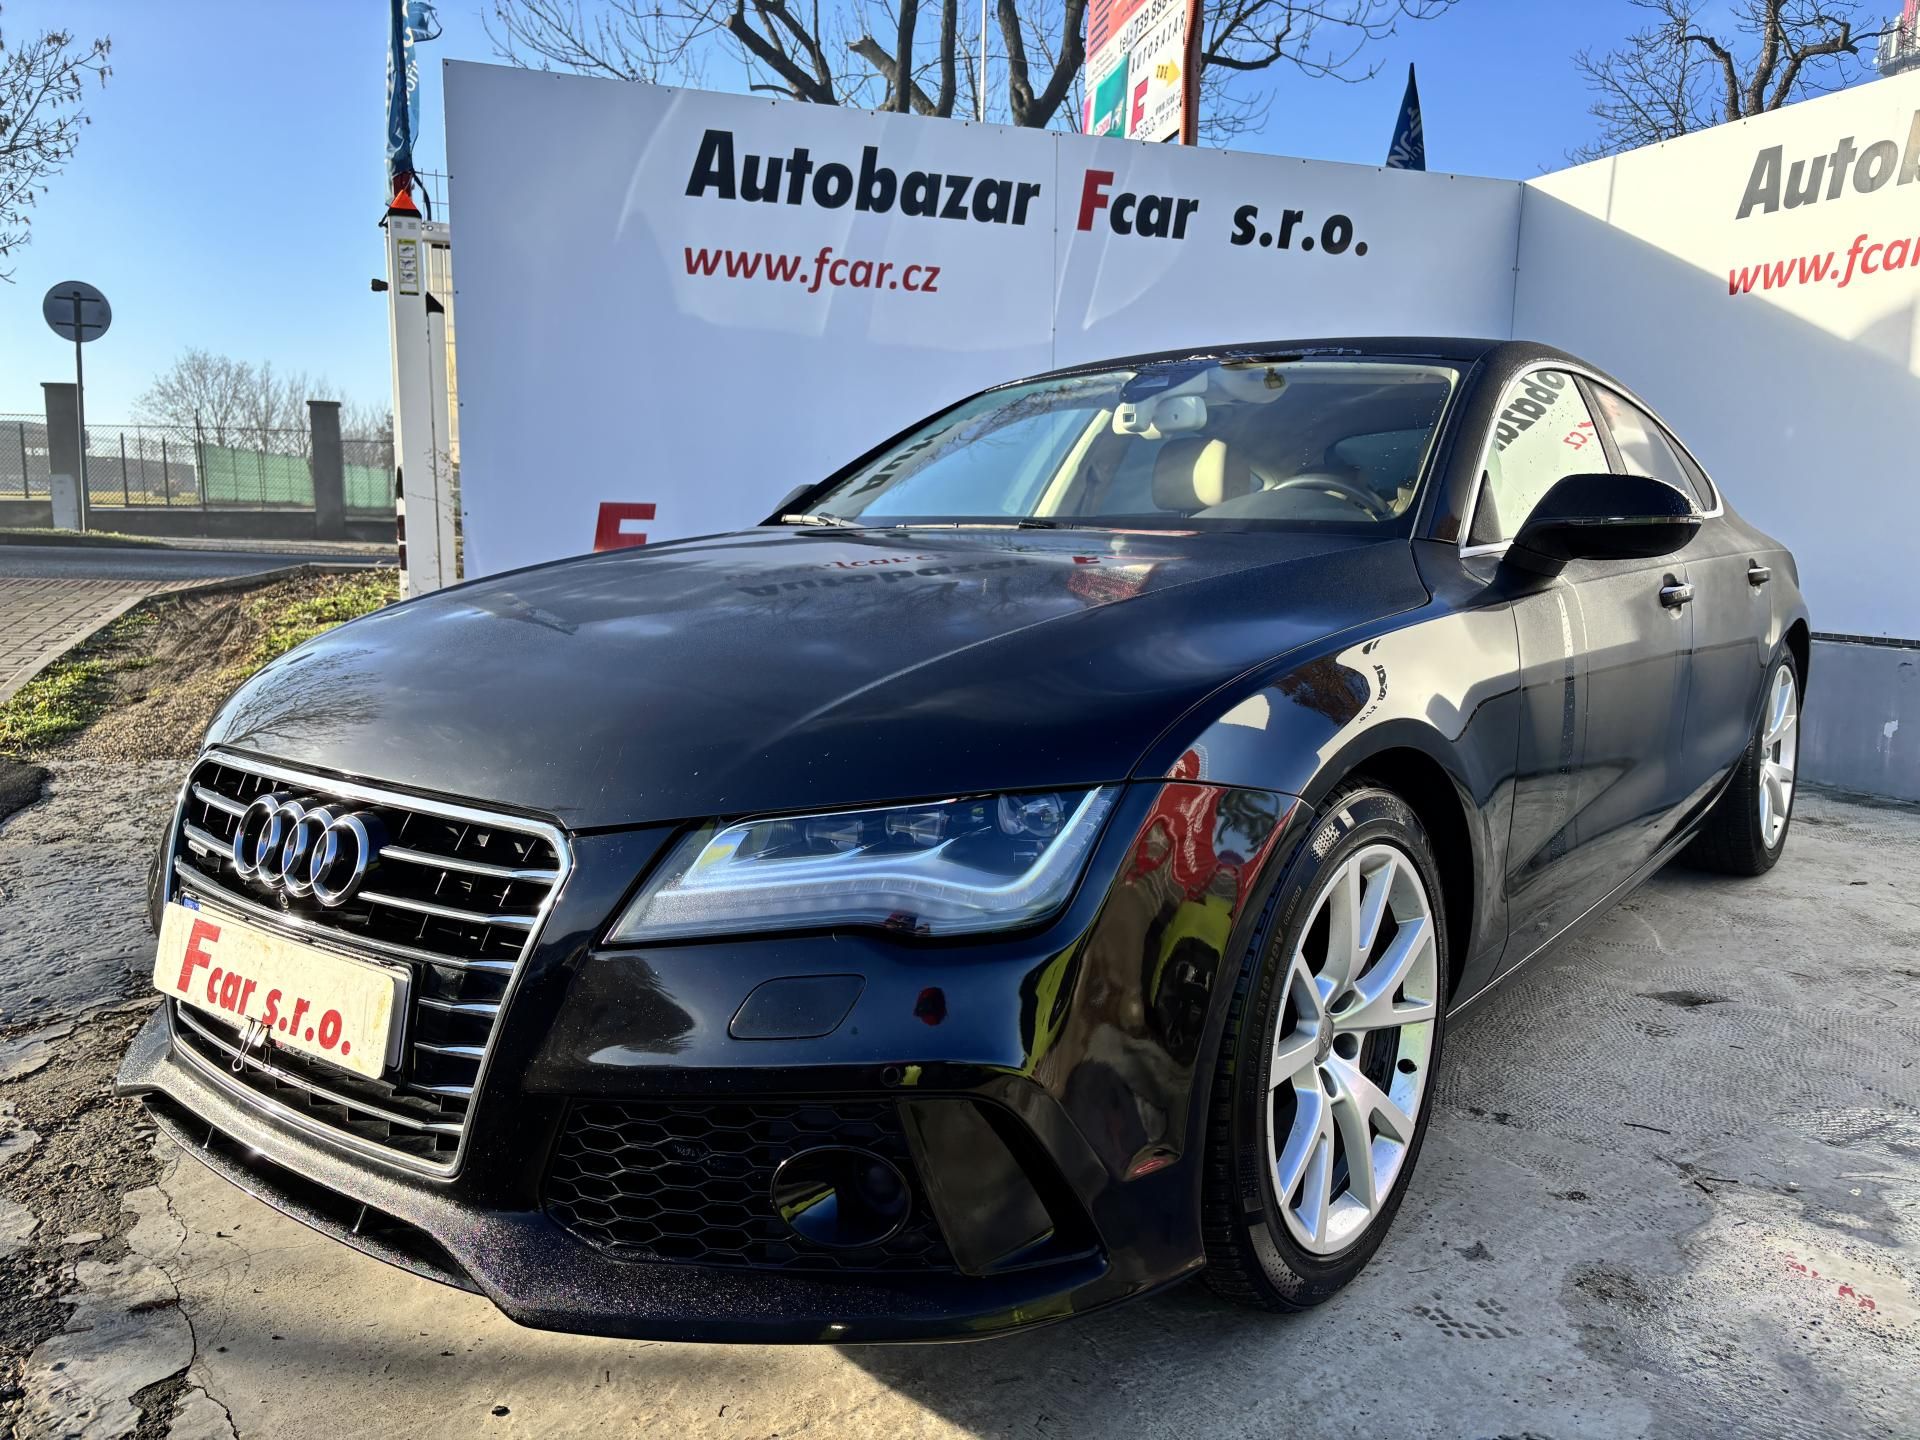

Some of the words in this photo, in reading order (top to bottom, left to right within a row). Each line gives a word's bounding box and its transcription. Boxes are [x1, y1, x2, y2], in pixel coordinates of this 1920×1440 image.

[685, 128, 1041, 225] Autobazar
[1077, 169, 1200, 240] Fcar
[1230, 204, 1369, 257] s.r.o.
[684, 246, 942, 293] www.fcar.cz
[261, 988, 352, 1056] s.r.o.
